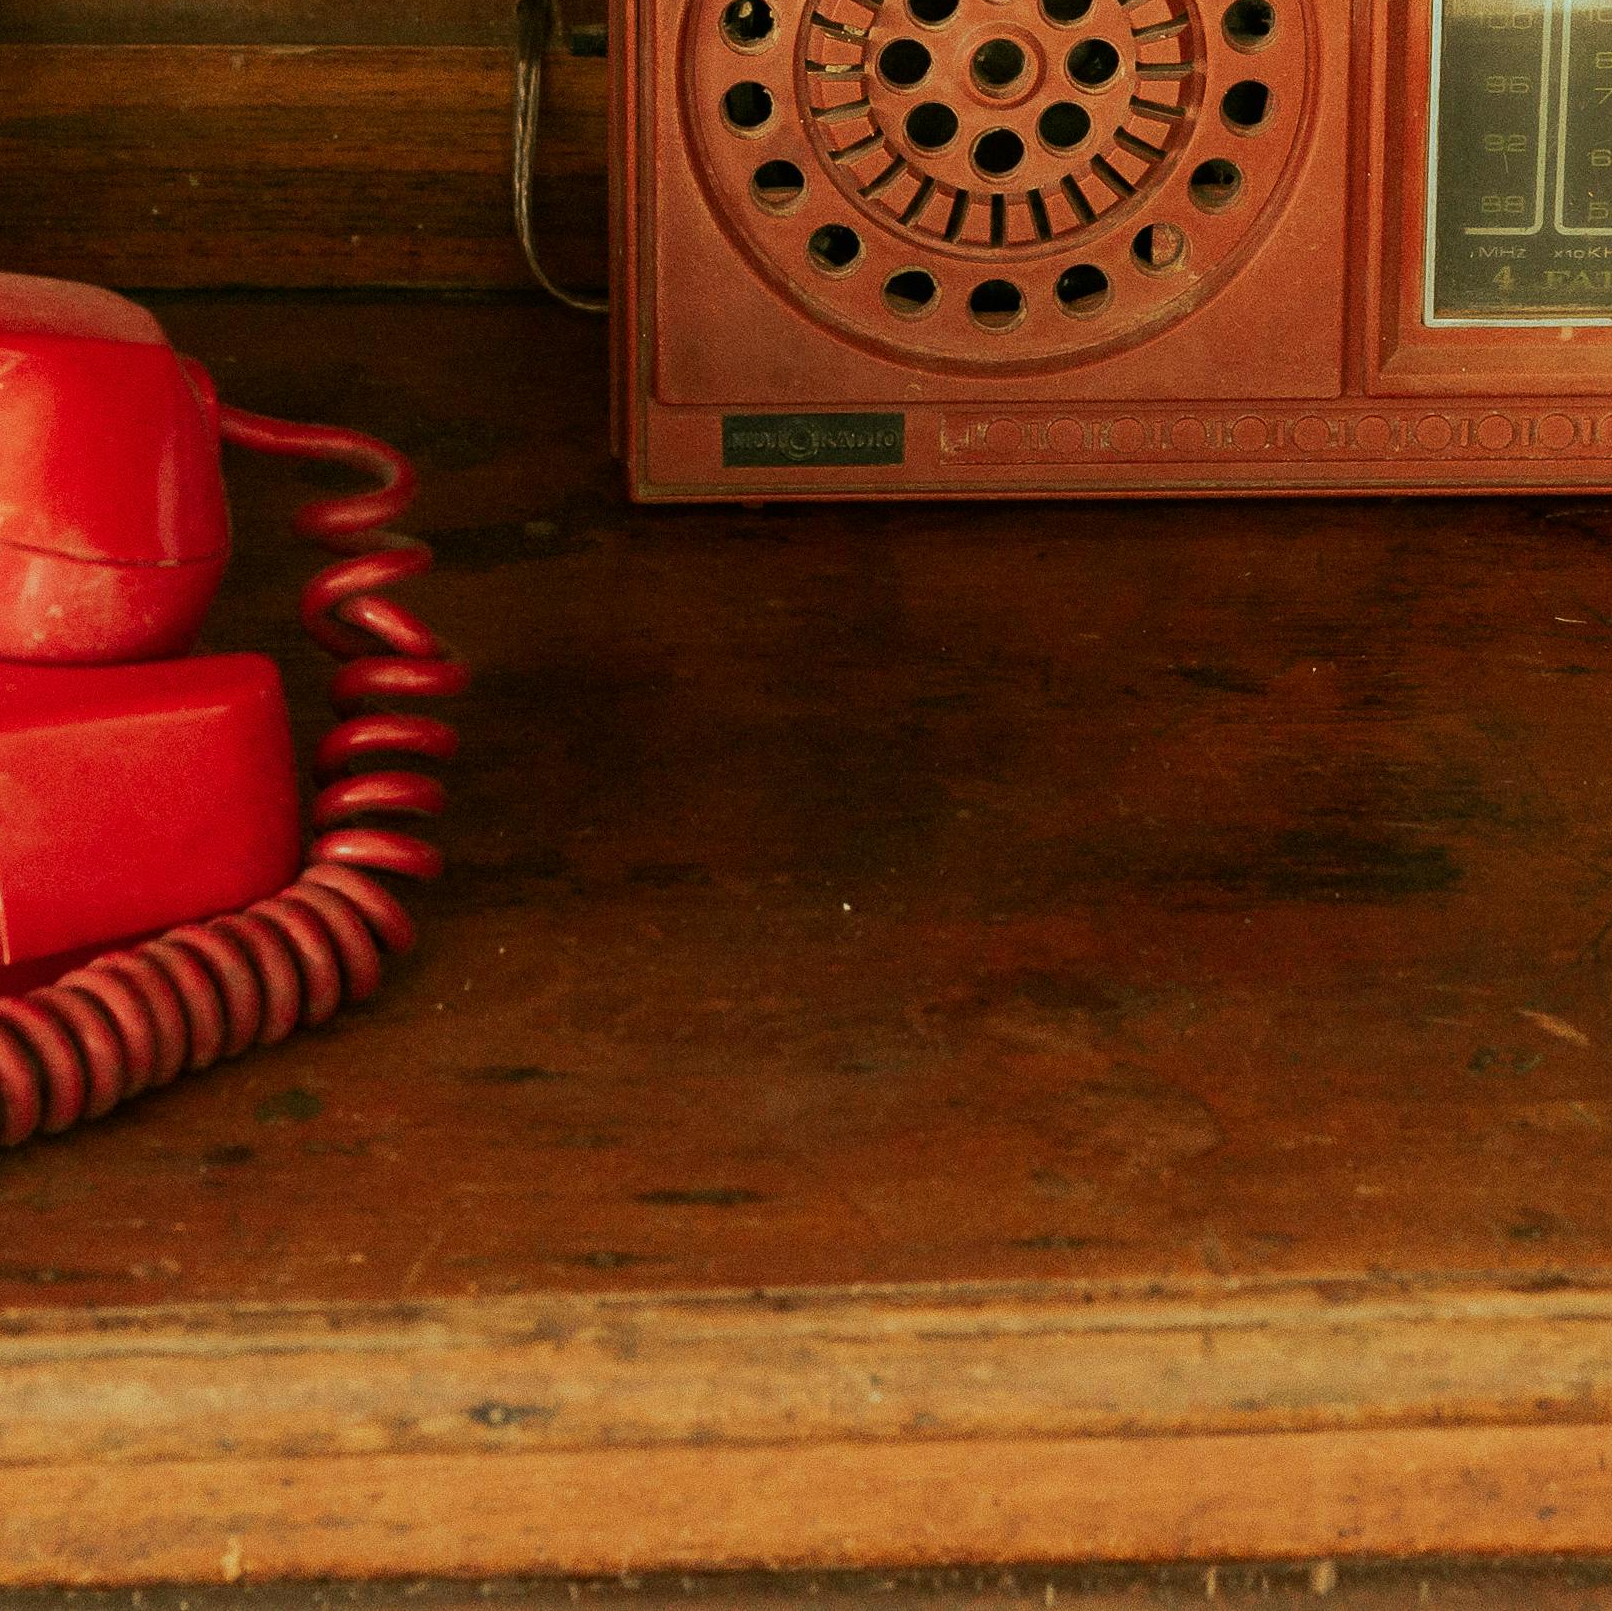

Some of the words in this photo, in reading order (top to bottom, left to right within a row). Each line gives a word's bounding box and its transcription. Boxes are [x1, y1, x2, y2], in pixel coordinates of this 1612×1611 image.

[1484, 74, 1532, 94] 96
[1482, 132, 1528, 153] 92
[1480, 194, 1526, 214] 88
